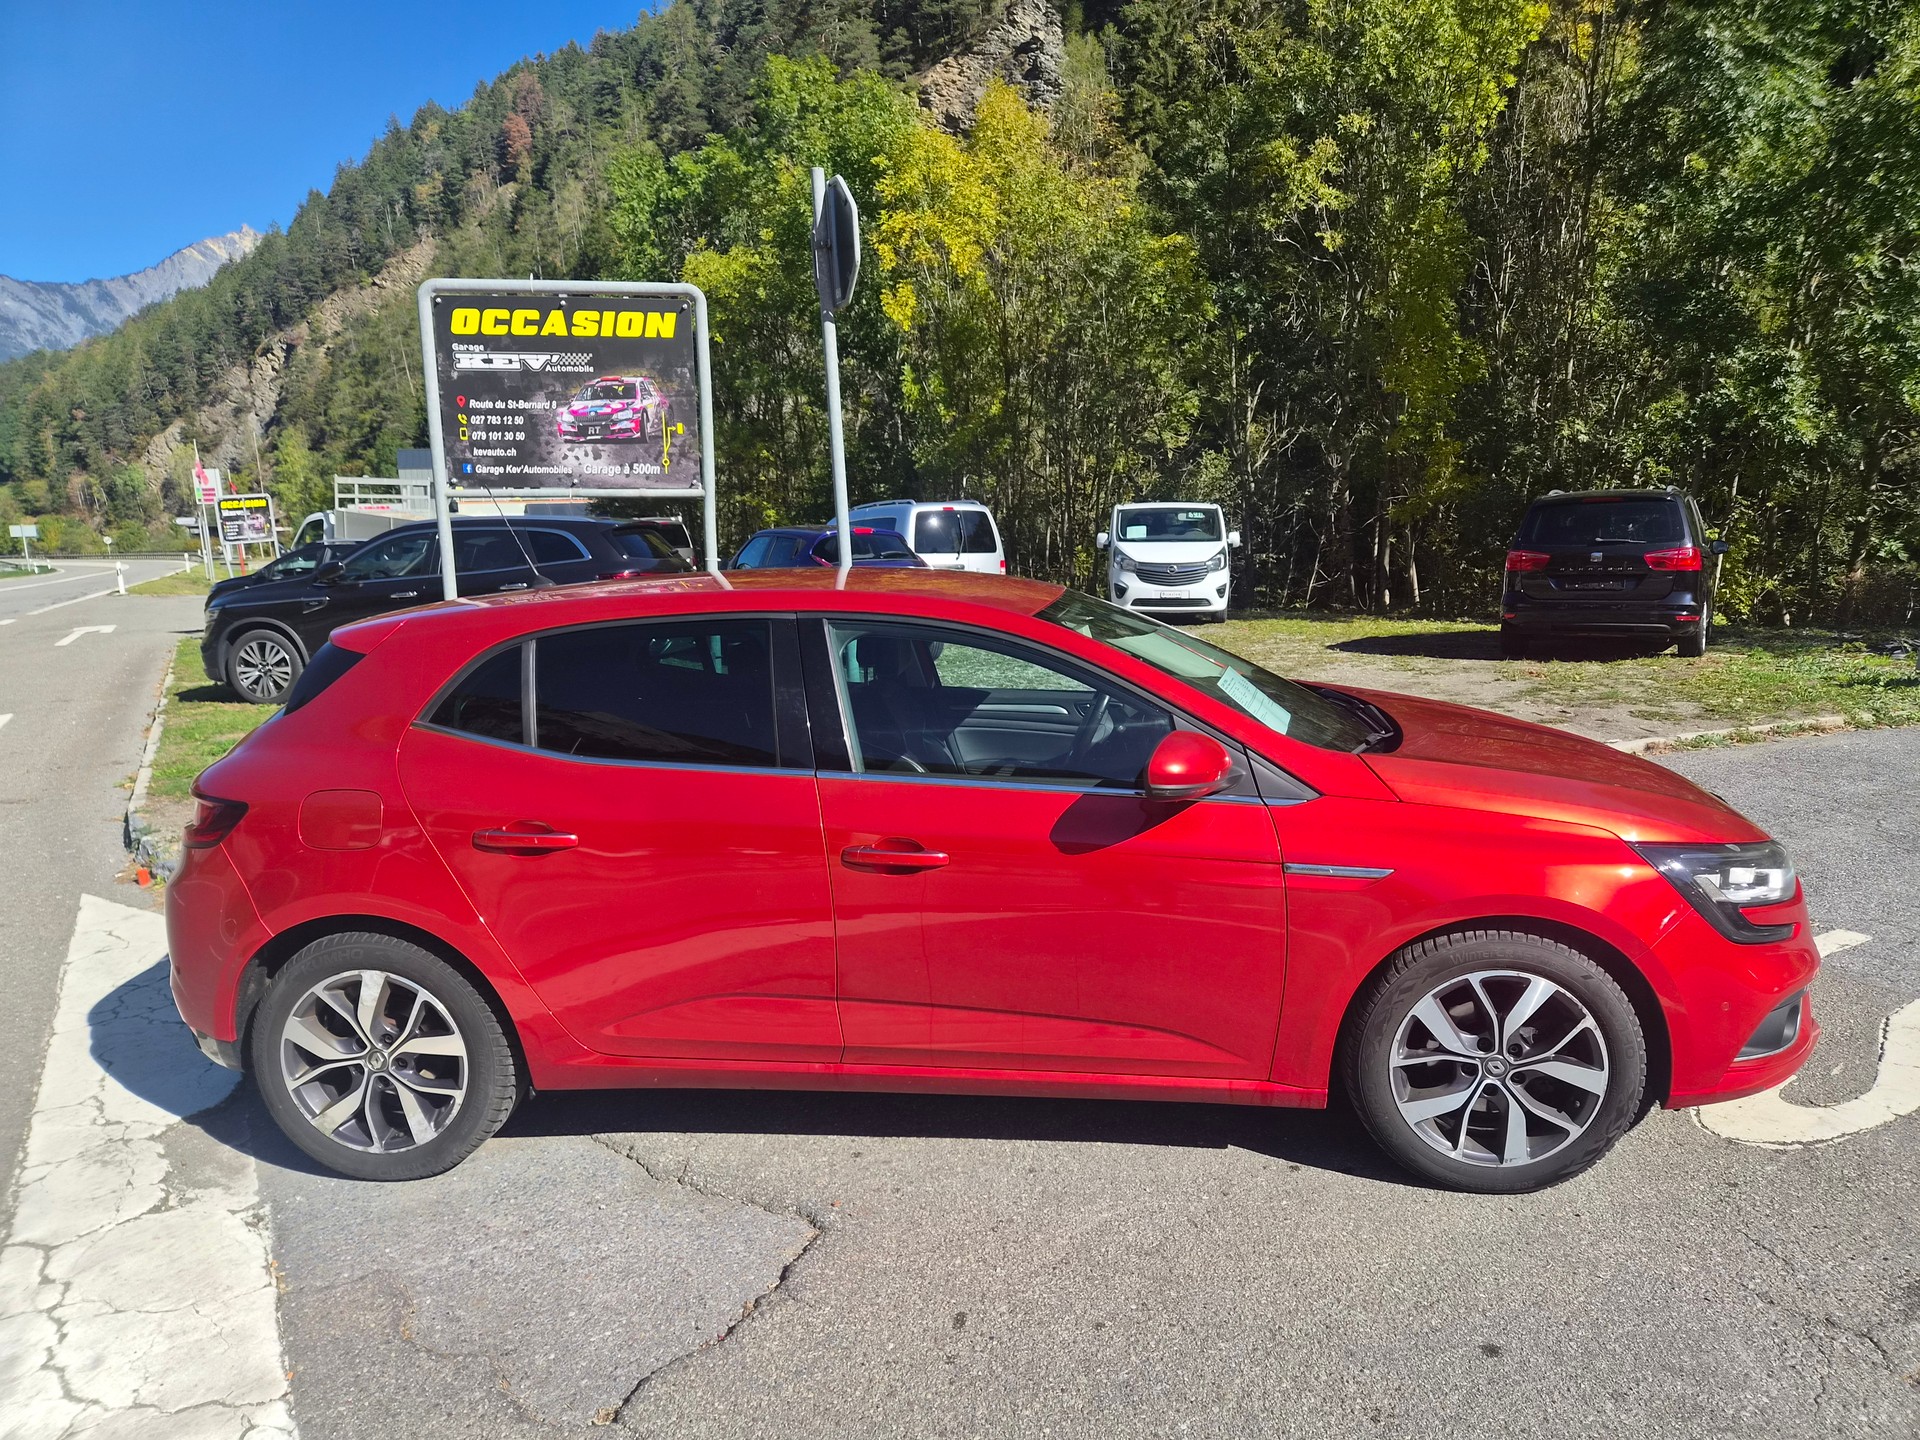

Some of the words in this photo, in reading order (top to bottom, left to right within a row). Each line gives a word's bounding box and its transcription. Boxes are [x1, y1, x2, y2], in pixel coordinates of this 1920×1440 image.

[450, 308, 677, 338] OCCASION
[452, 343, 485, 352] Garage
[545, 365, 594, 373] Automobile
[469, 399, 494, 409] Route
[495, 400, 506, 409] du
[507, 400, 550, 409] St-Bernard
[551, 401, 557, 409] 8
[470, 415, 485, 425] 027
[487, 415, 501, 425] 783
[503, 416, 513, 425] 12
[514, 416, 524, 425] 50
[588, 426, 601, 434] RT
[472, 431, 487, 440] 079
[488, 432, 502, 440] 101
[504, 432, 514, 441] 30
[515, 432, 525, 441] 50
[473, 447, 517, 457] kevauto.ch
[475, 464, 505, 475] Garage
[506, 464, 573, 474] Kev'Automobiles
[583, 463, 621, 476] Garage
[623, 463, 630, 475] à
[632, 463, 660, 475] 500m
